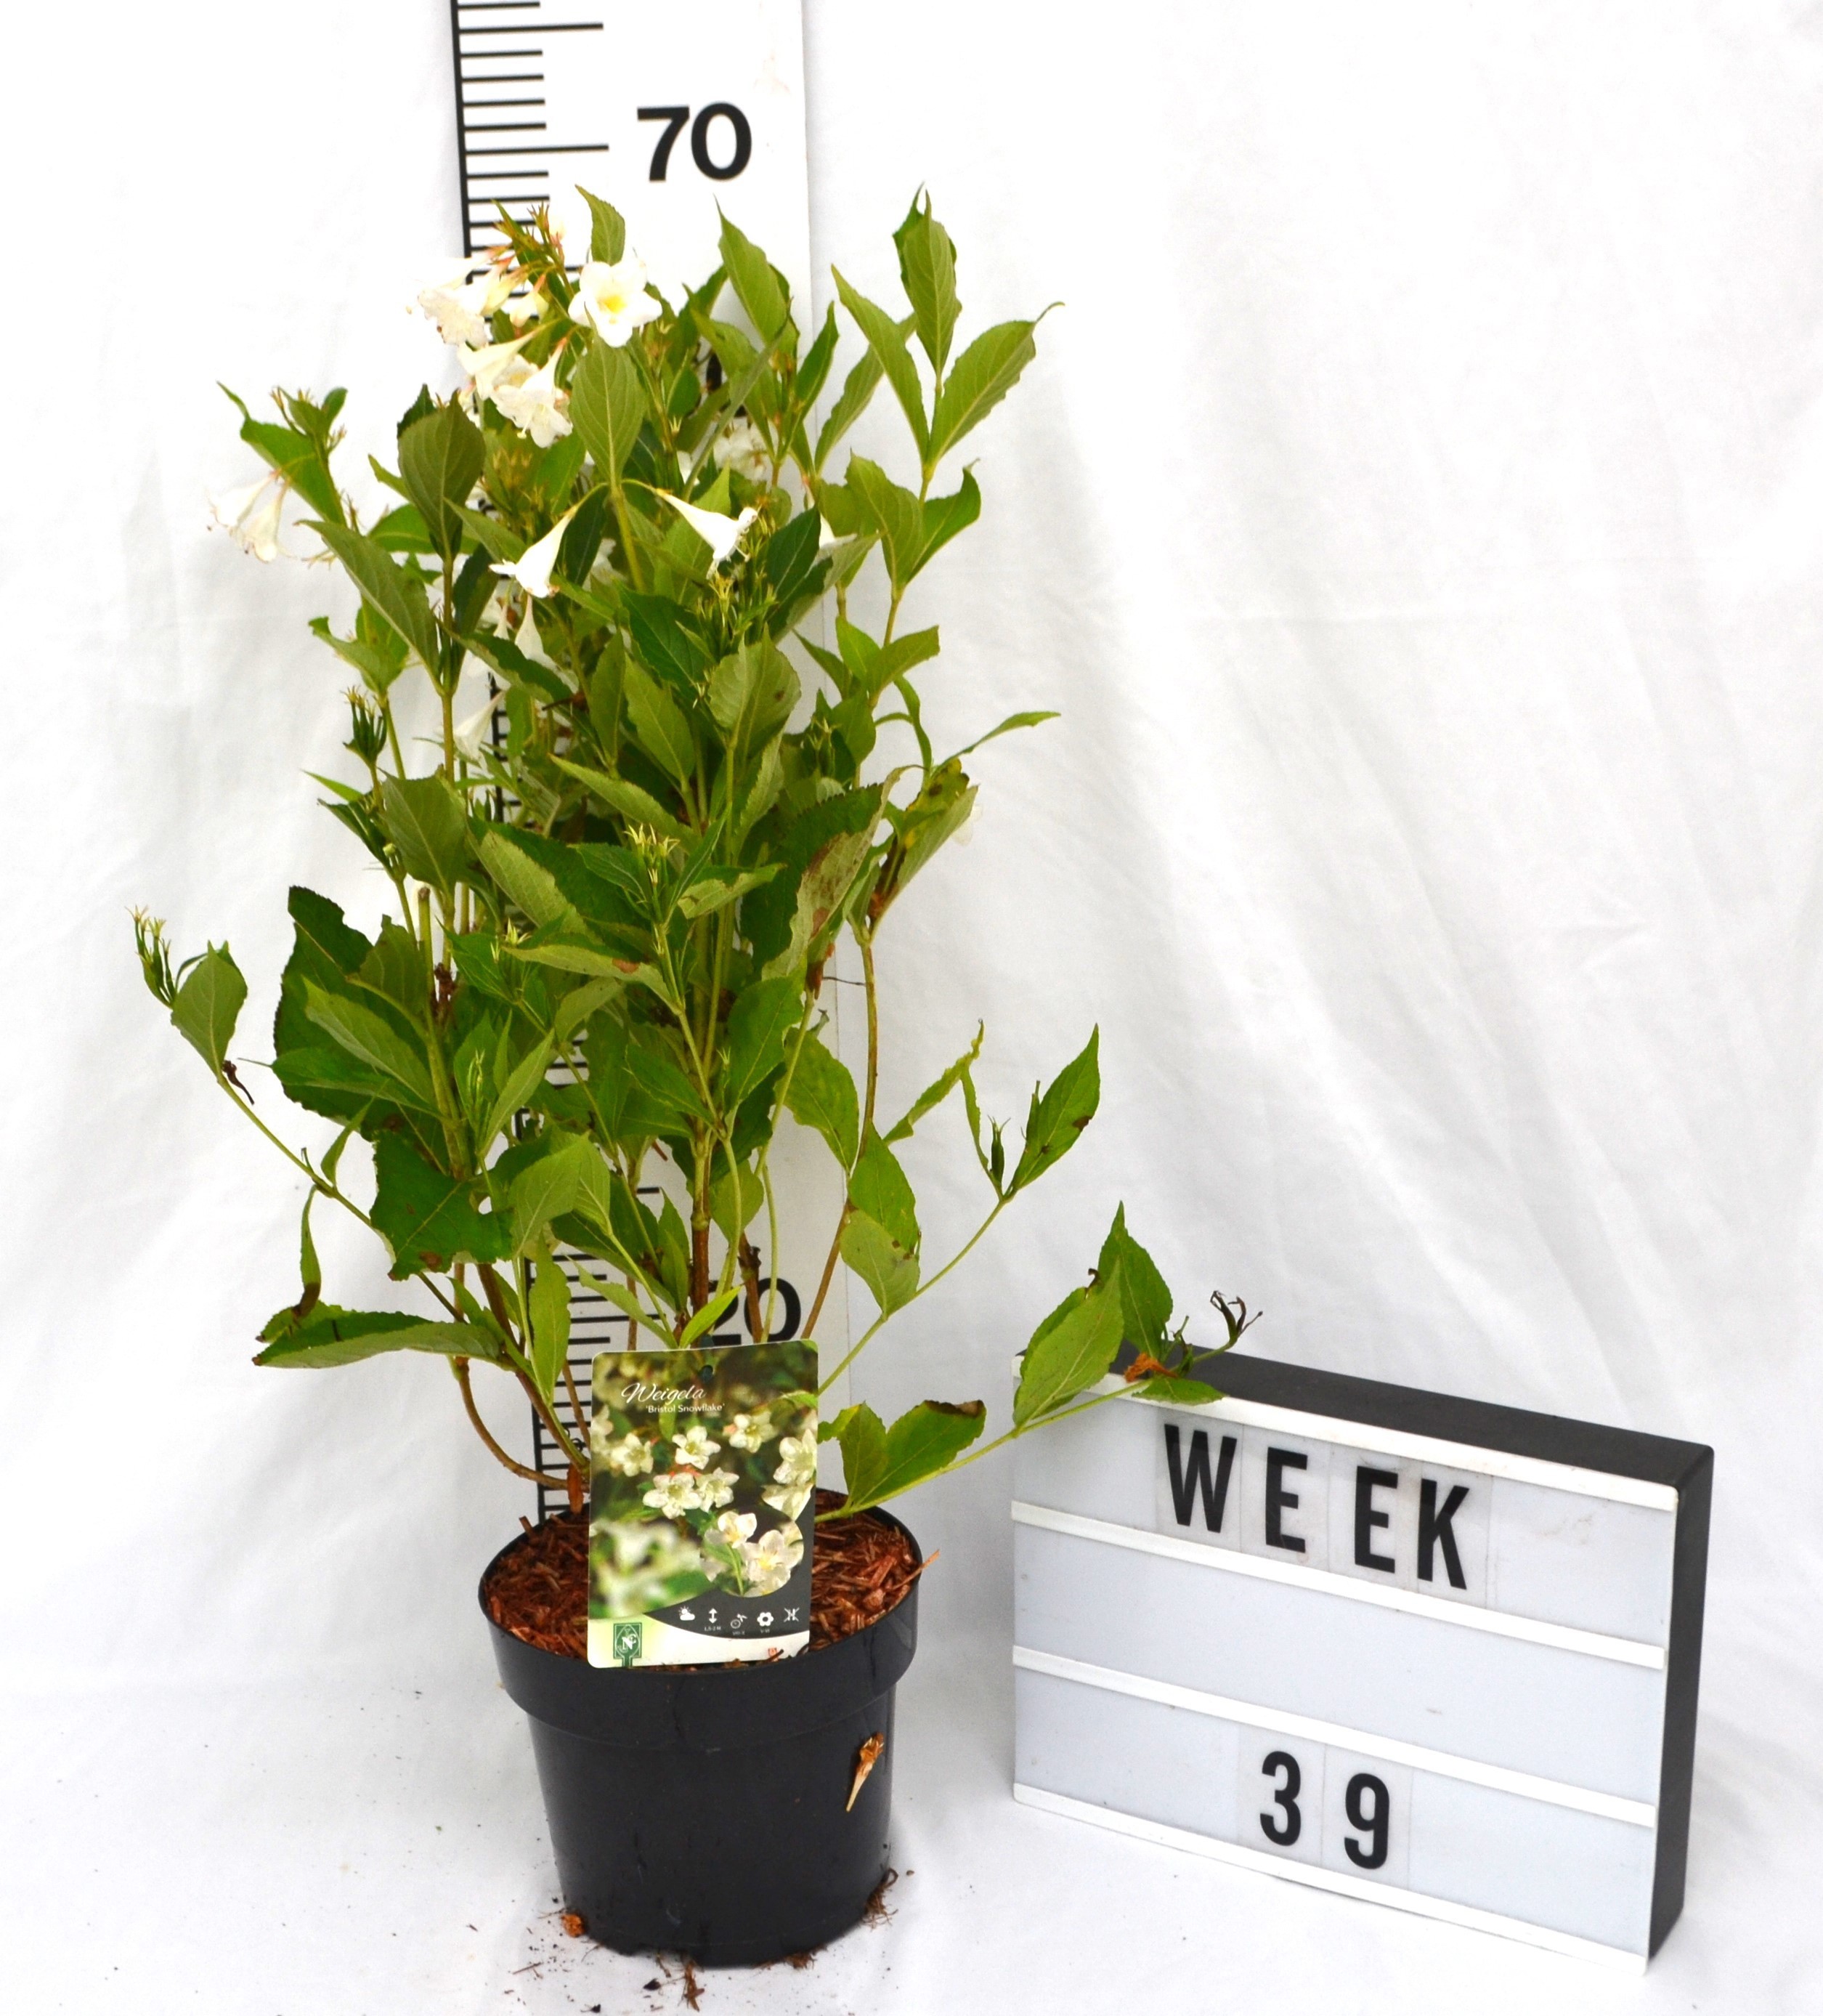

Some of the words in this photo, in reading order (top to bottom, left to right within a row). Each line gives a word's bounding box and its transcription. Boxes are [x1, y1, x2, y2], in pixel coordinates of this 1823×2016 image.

[638, 102, 752, 182] 70
[621, 1383, 707, 1405] Weigela
[1164, 1423, 1470, 1590] WEEK
[1259, 1750, 1390, 1870] 39
